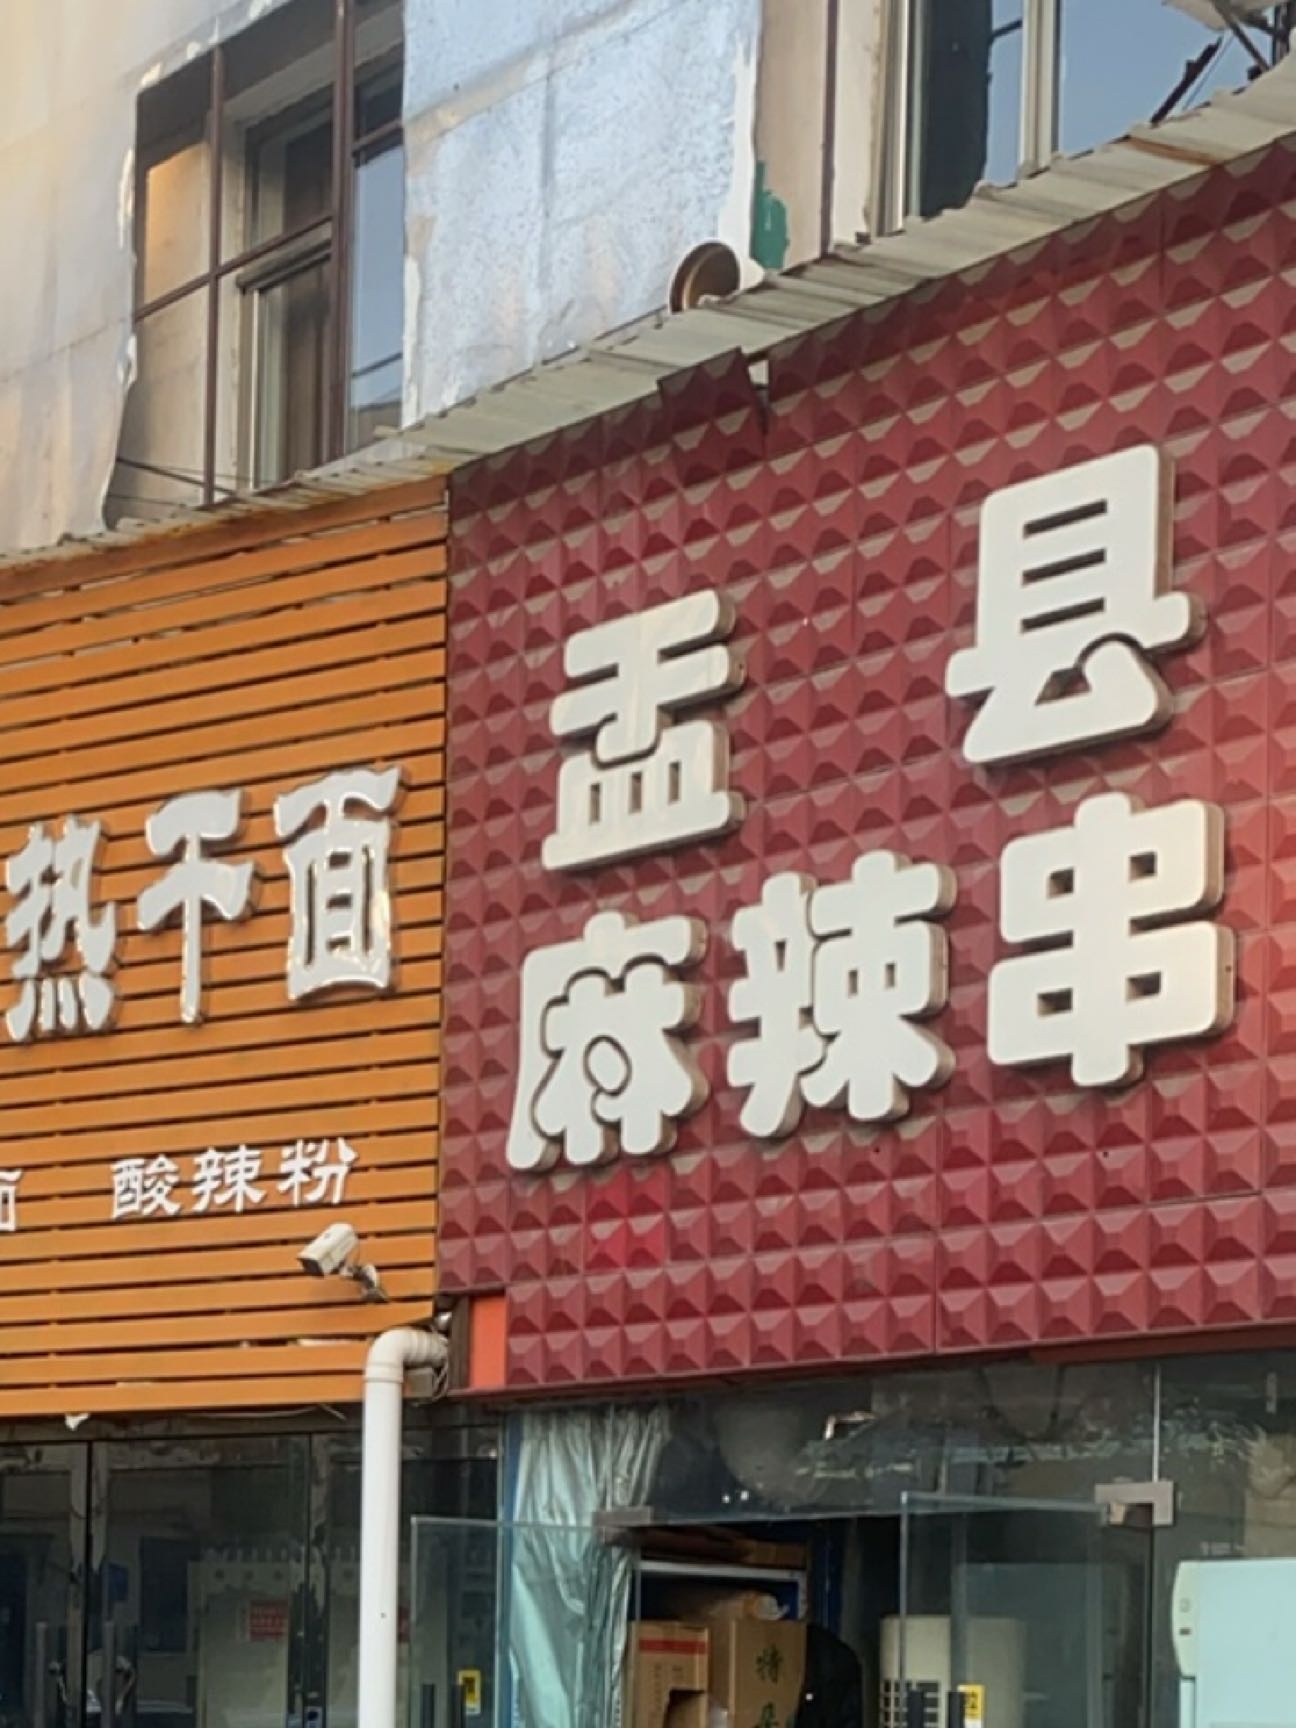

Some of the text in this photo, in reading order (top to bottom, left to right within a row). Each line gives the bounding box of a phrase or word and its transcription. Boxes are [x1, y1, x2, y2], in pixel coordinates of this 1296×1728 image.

[507, 793, 1237, 1172] 麻辣串
[110, 1136, 359, 1220] 酸辣粉
